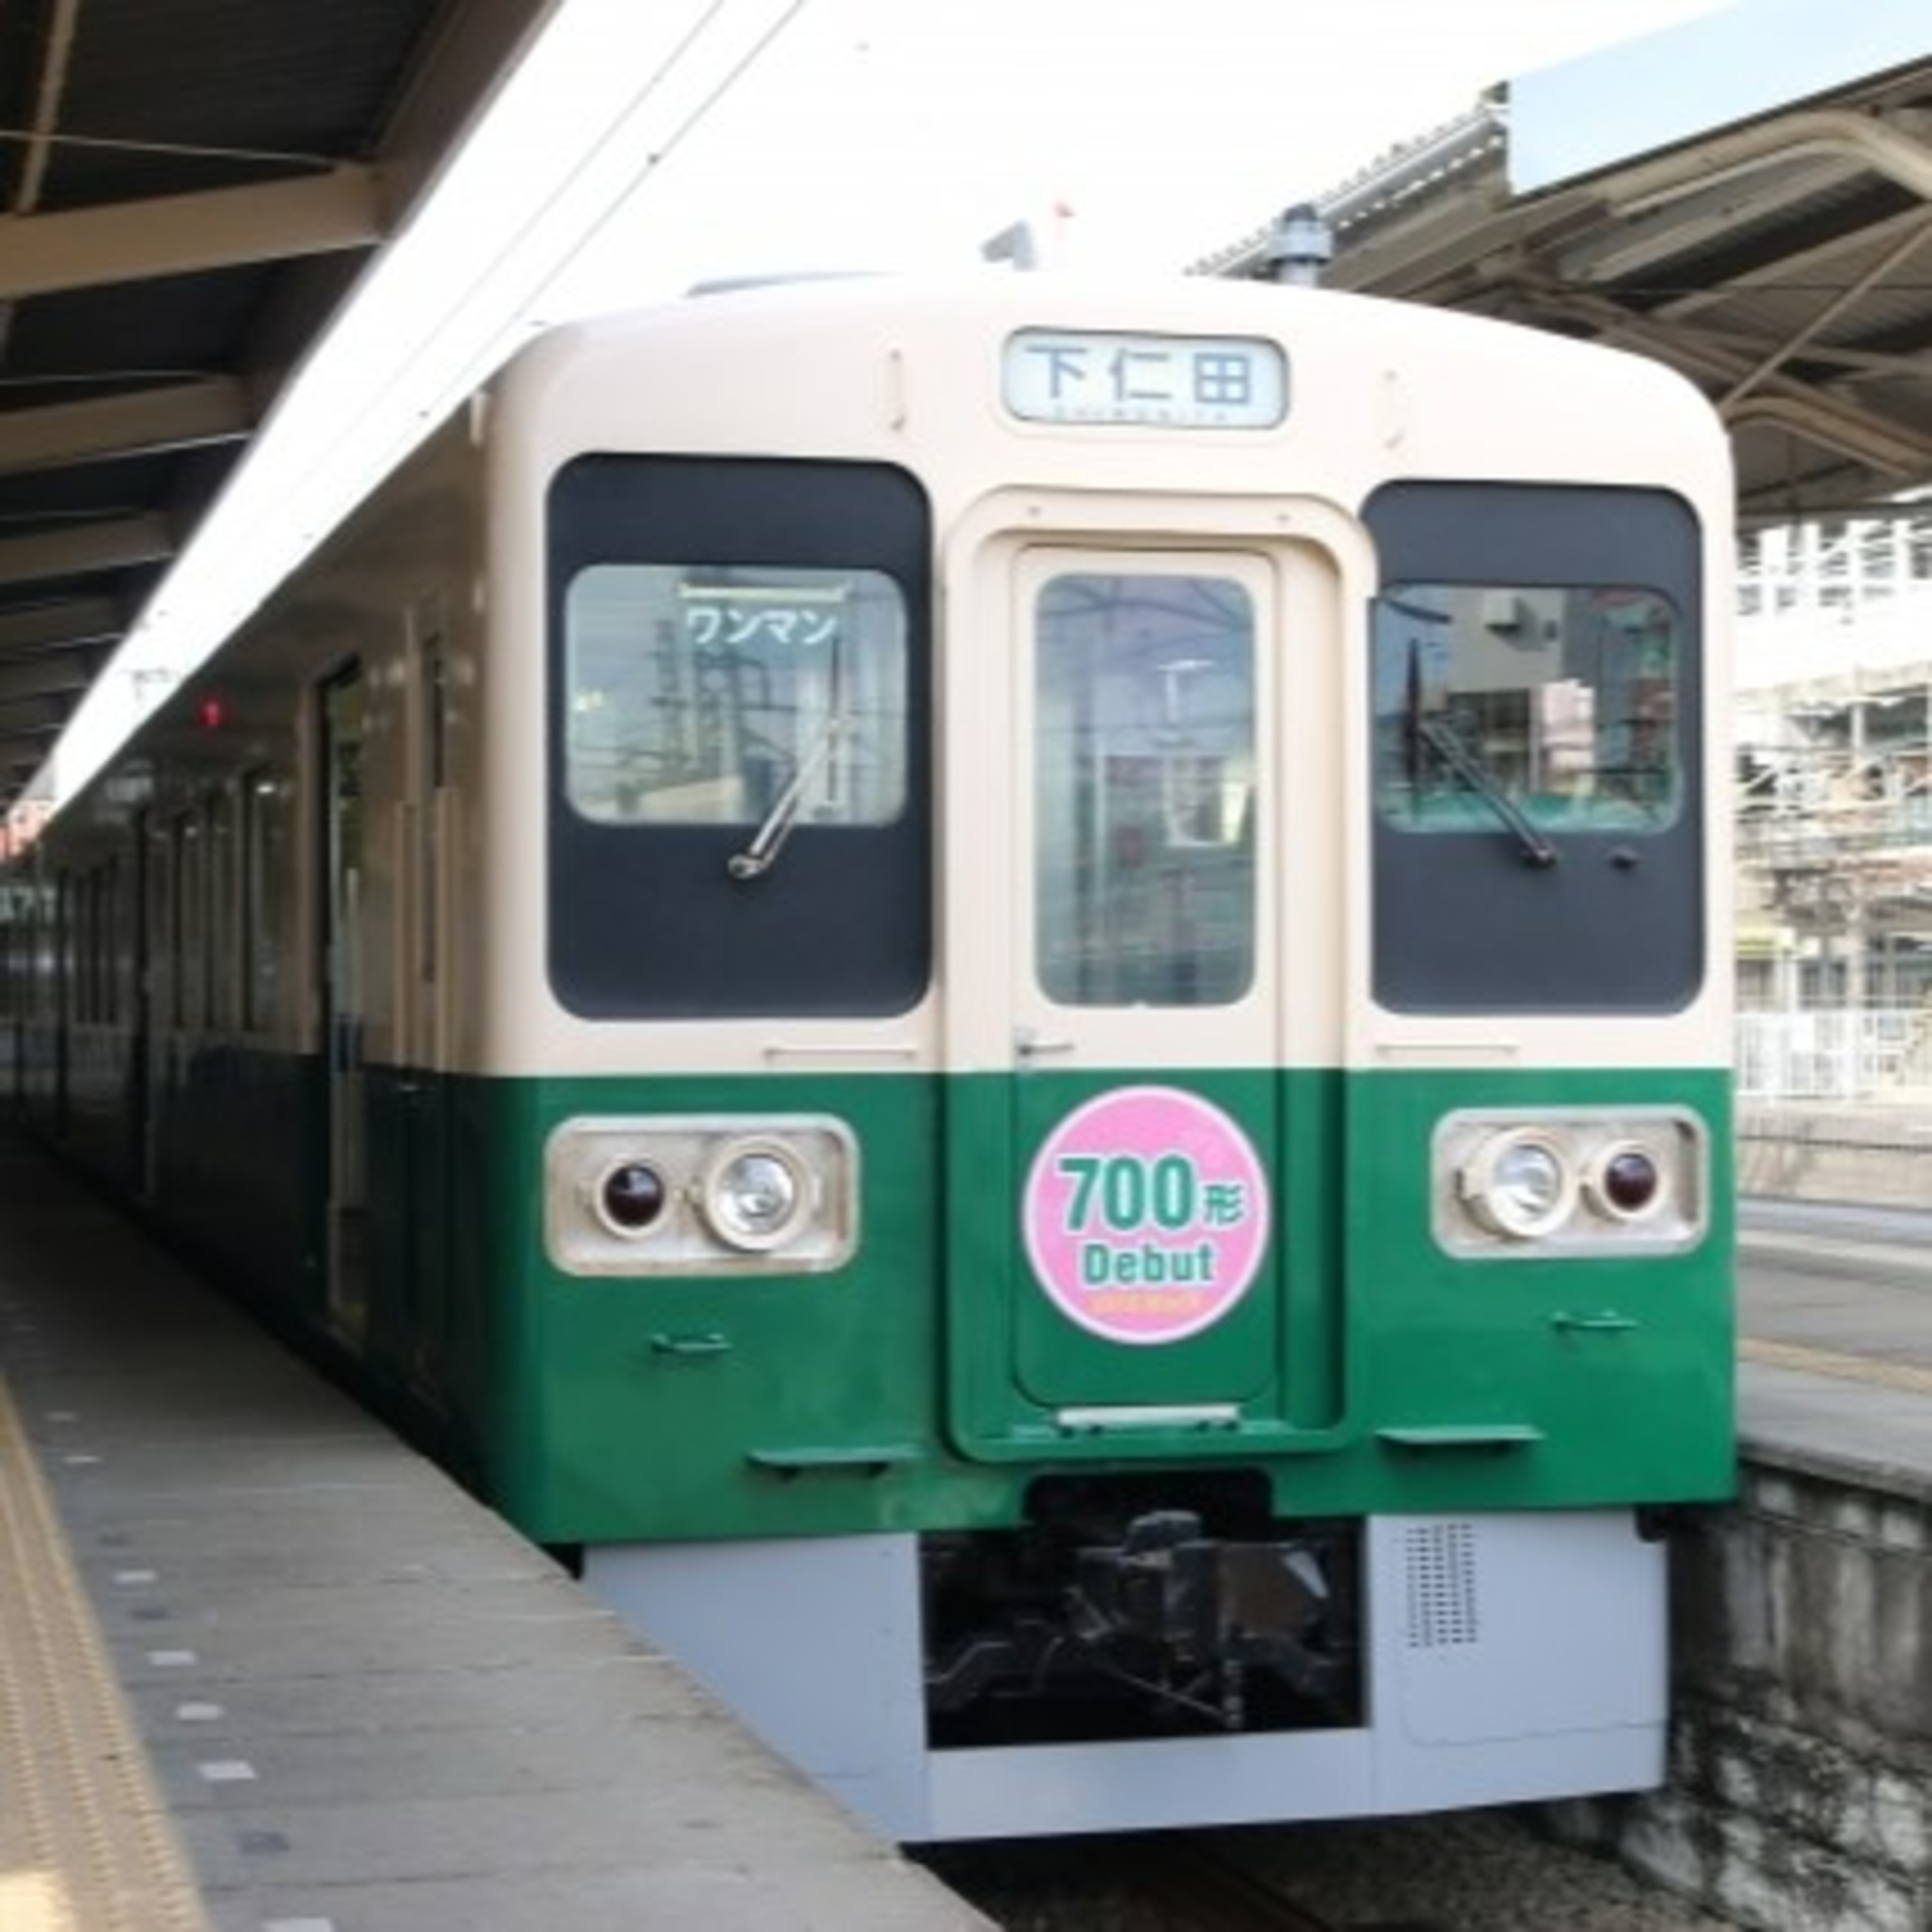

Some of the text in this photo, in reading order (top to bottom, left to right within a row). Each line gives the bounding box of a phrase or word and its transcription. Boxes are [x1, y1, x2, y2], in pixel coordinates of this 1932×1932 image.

[1025, 345, 1251, 404] 下仁田
[687, 609, 838, 643] ワンマン
[1058, 1155, 1244, 1231] 700形
[1083, 1242, 1213, 1284] Debut
